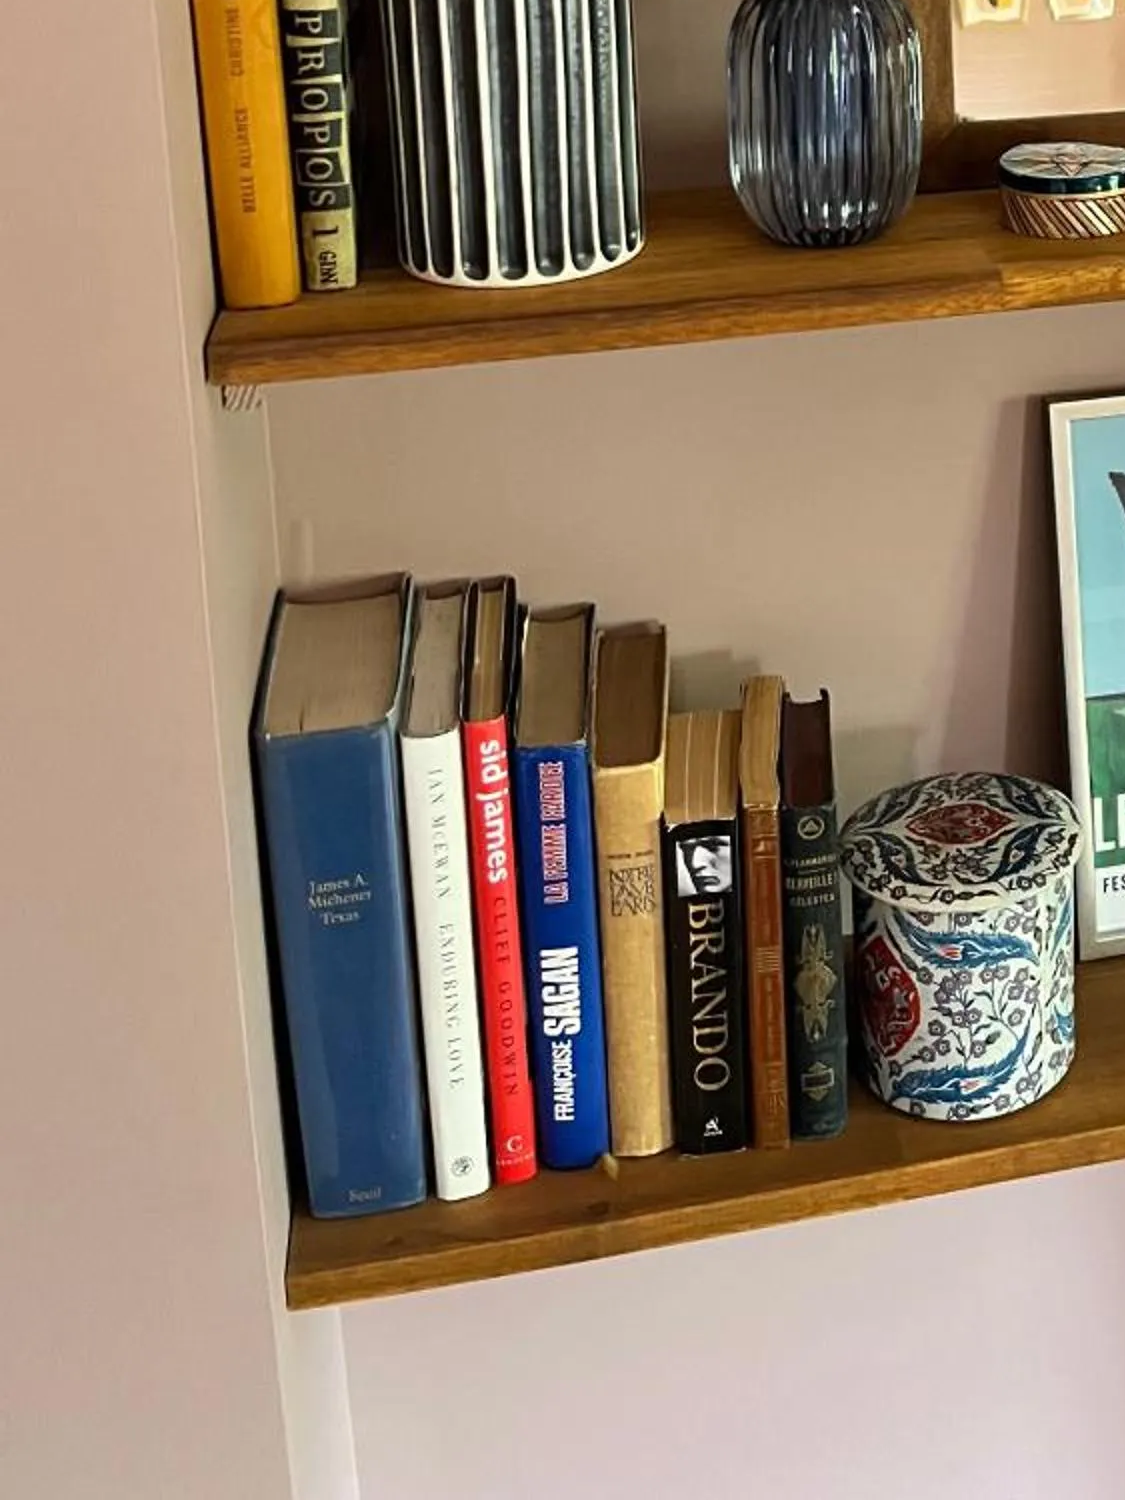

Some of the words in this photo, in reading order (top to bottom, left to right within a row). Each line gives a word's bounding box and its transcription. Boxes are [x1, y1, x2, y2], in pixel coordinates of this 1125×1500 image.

[427, 768, 445, 805] IAN
[479, 739, 508, 785] sid
[475, 786, 509, 885] james
[308, 890, 371, 909] Michener
[309, 879, 349, 897] James
[543, 881, 569, 905] LA
[320, 911, 360, 925] Texas
[438, 922, 460, 1030] ENDURING
[540, 946, 582, 1037] SAGAN
[687, 898, 731, 1092] BRANDO
[446, 1036, 465, 1091] LOVE
[498, 981, 519, 1098] GOODWIN
[551, 1038, 577, 1122] FRANÇOISE
